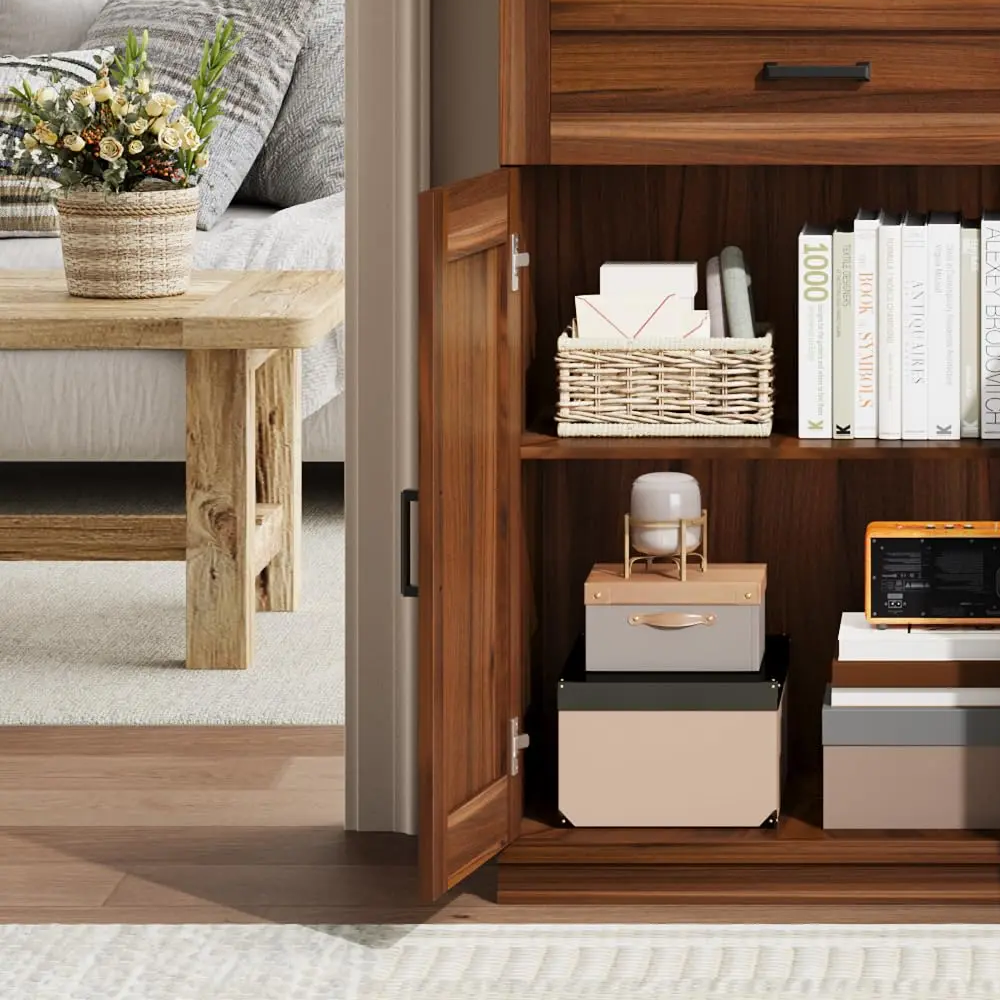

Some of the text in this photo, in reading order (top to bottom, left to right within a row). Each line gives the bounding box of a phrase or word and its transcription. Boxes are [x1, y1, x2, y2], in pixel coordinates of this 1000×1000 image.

[803, 243, 829, 302] 1000
[858, 272, 874, 315] BOOK
[858, 332, 874, 409] SYMBOLS
